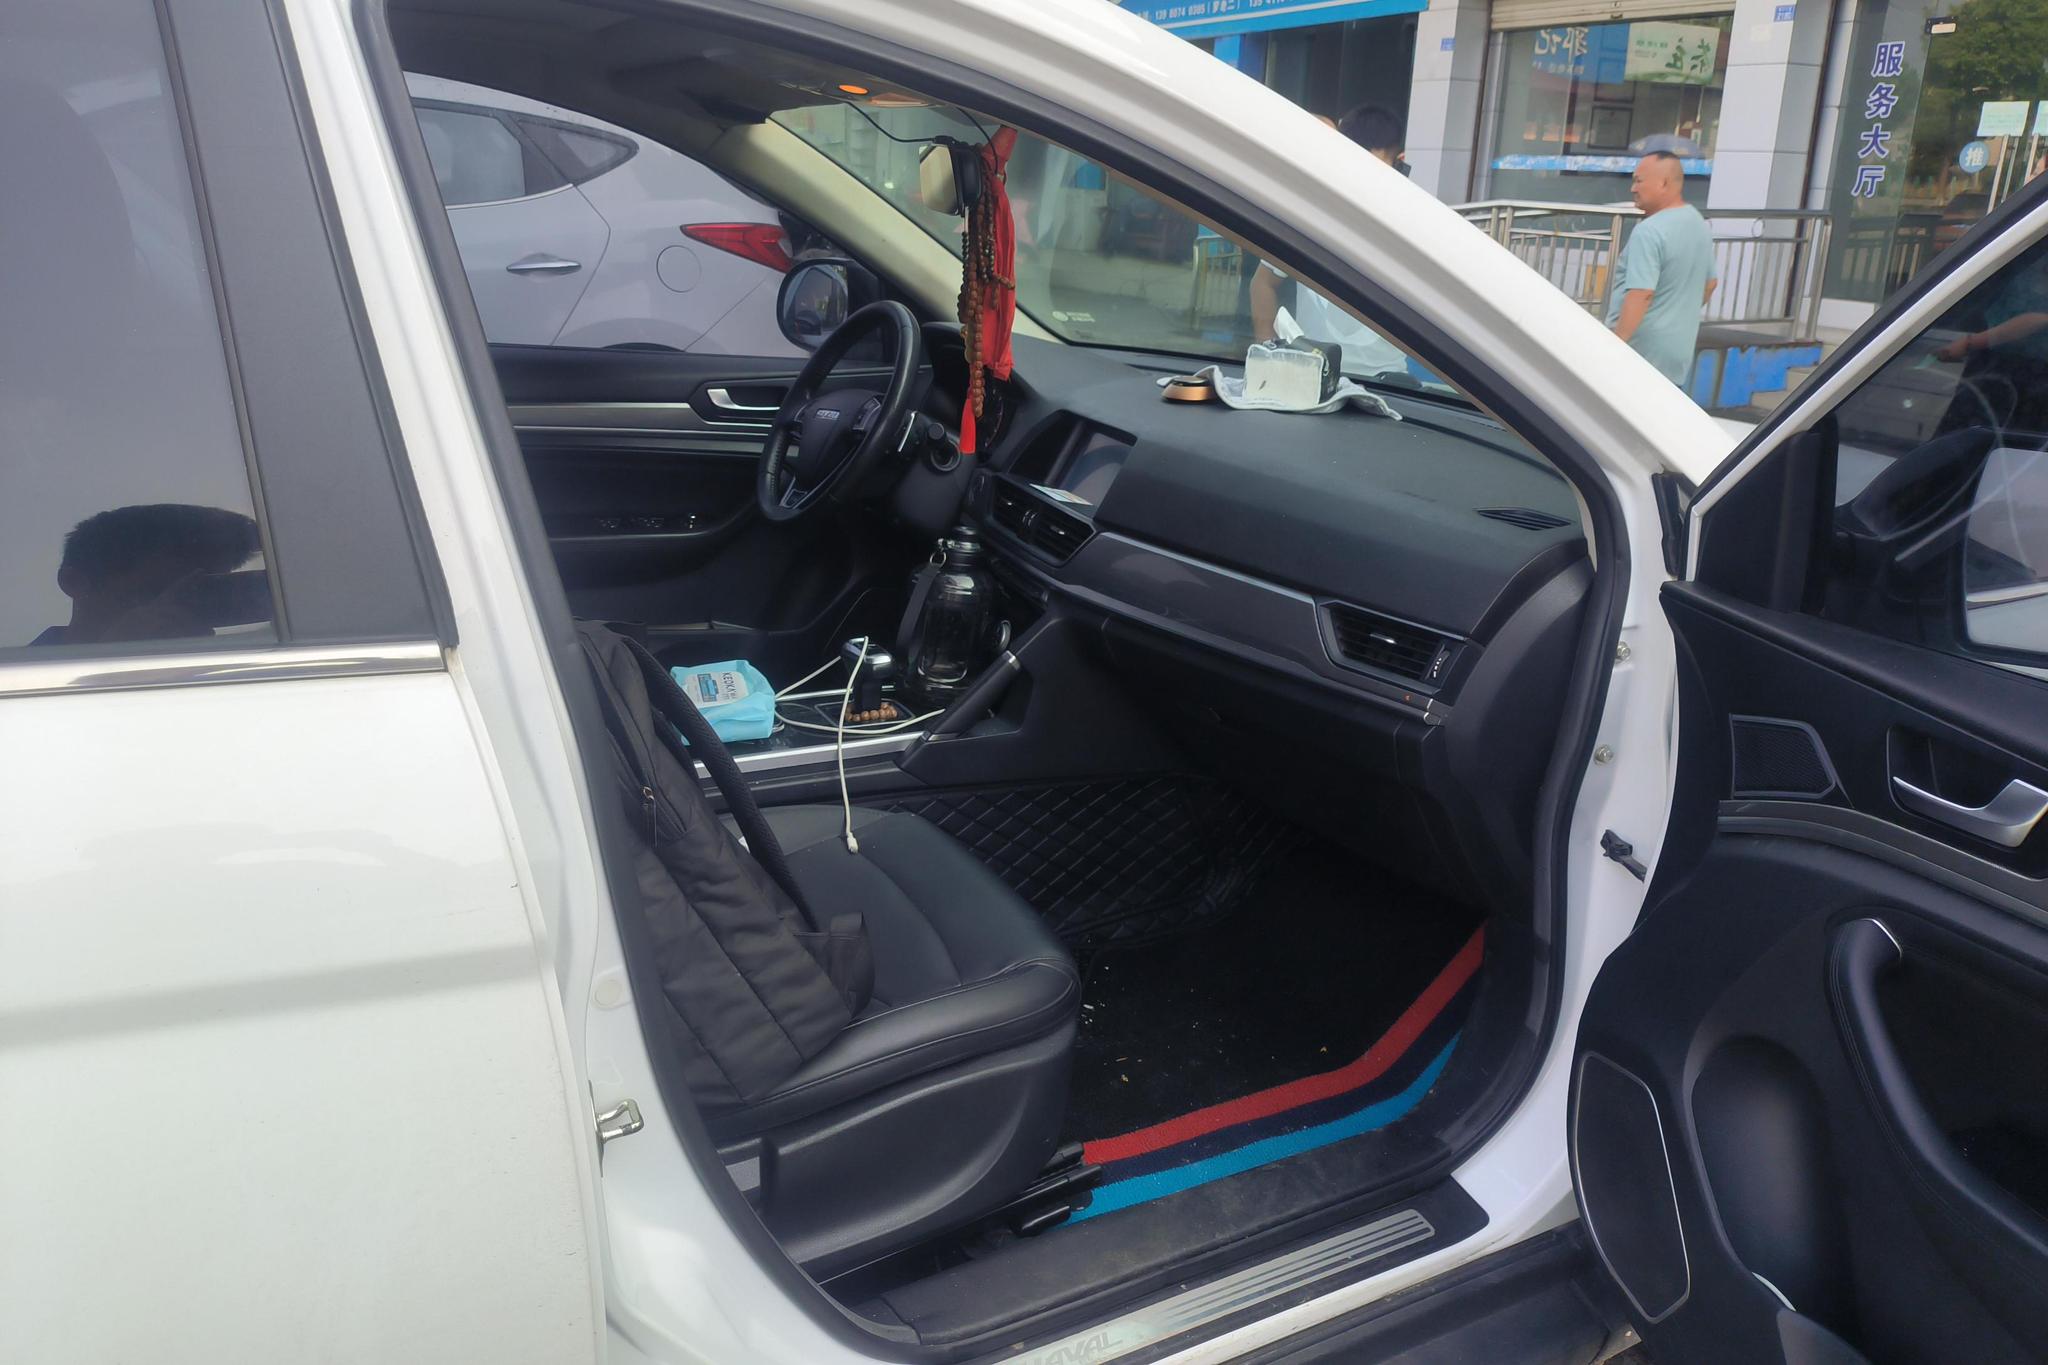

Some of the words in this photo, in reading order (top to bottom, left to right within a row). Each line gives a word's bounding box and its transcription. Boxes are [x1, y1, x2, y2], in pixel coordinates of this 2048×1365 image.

[1850, 41, 1906, 198] 服务大厅
[1965, 147, 1984, 167] 推
